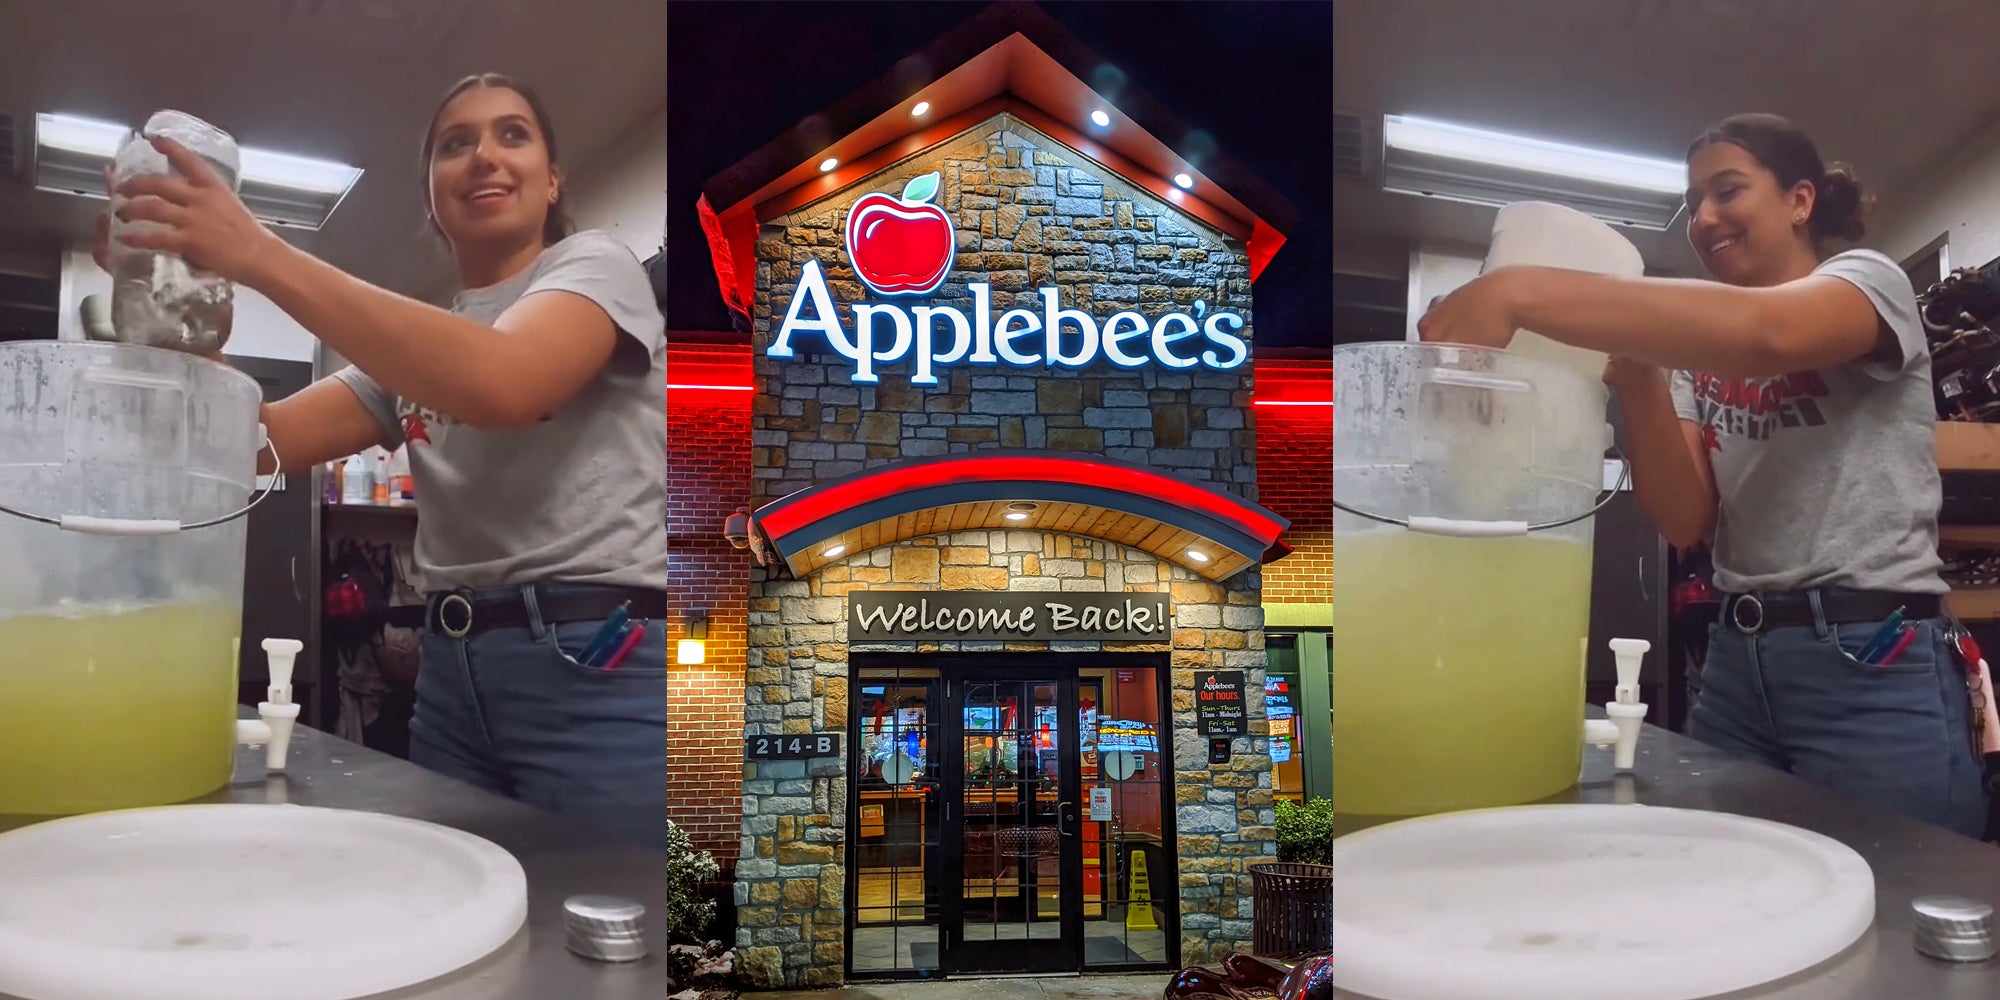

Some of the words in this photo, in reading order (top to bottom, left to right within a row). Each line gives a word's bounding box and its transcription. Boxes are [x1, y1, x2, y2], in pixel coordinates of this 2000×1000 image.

[767, 259, 1248, 384] Applebee's
[855, 597, 1034, 632] Welcome
[1045, 597, 1166, 632] Back!
[1200, 690, 1214, 701] Our
[1216, 690, 1240, 700] hours.
[755, 737, 832, 755] 214-B
